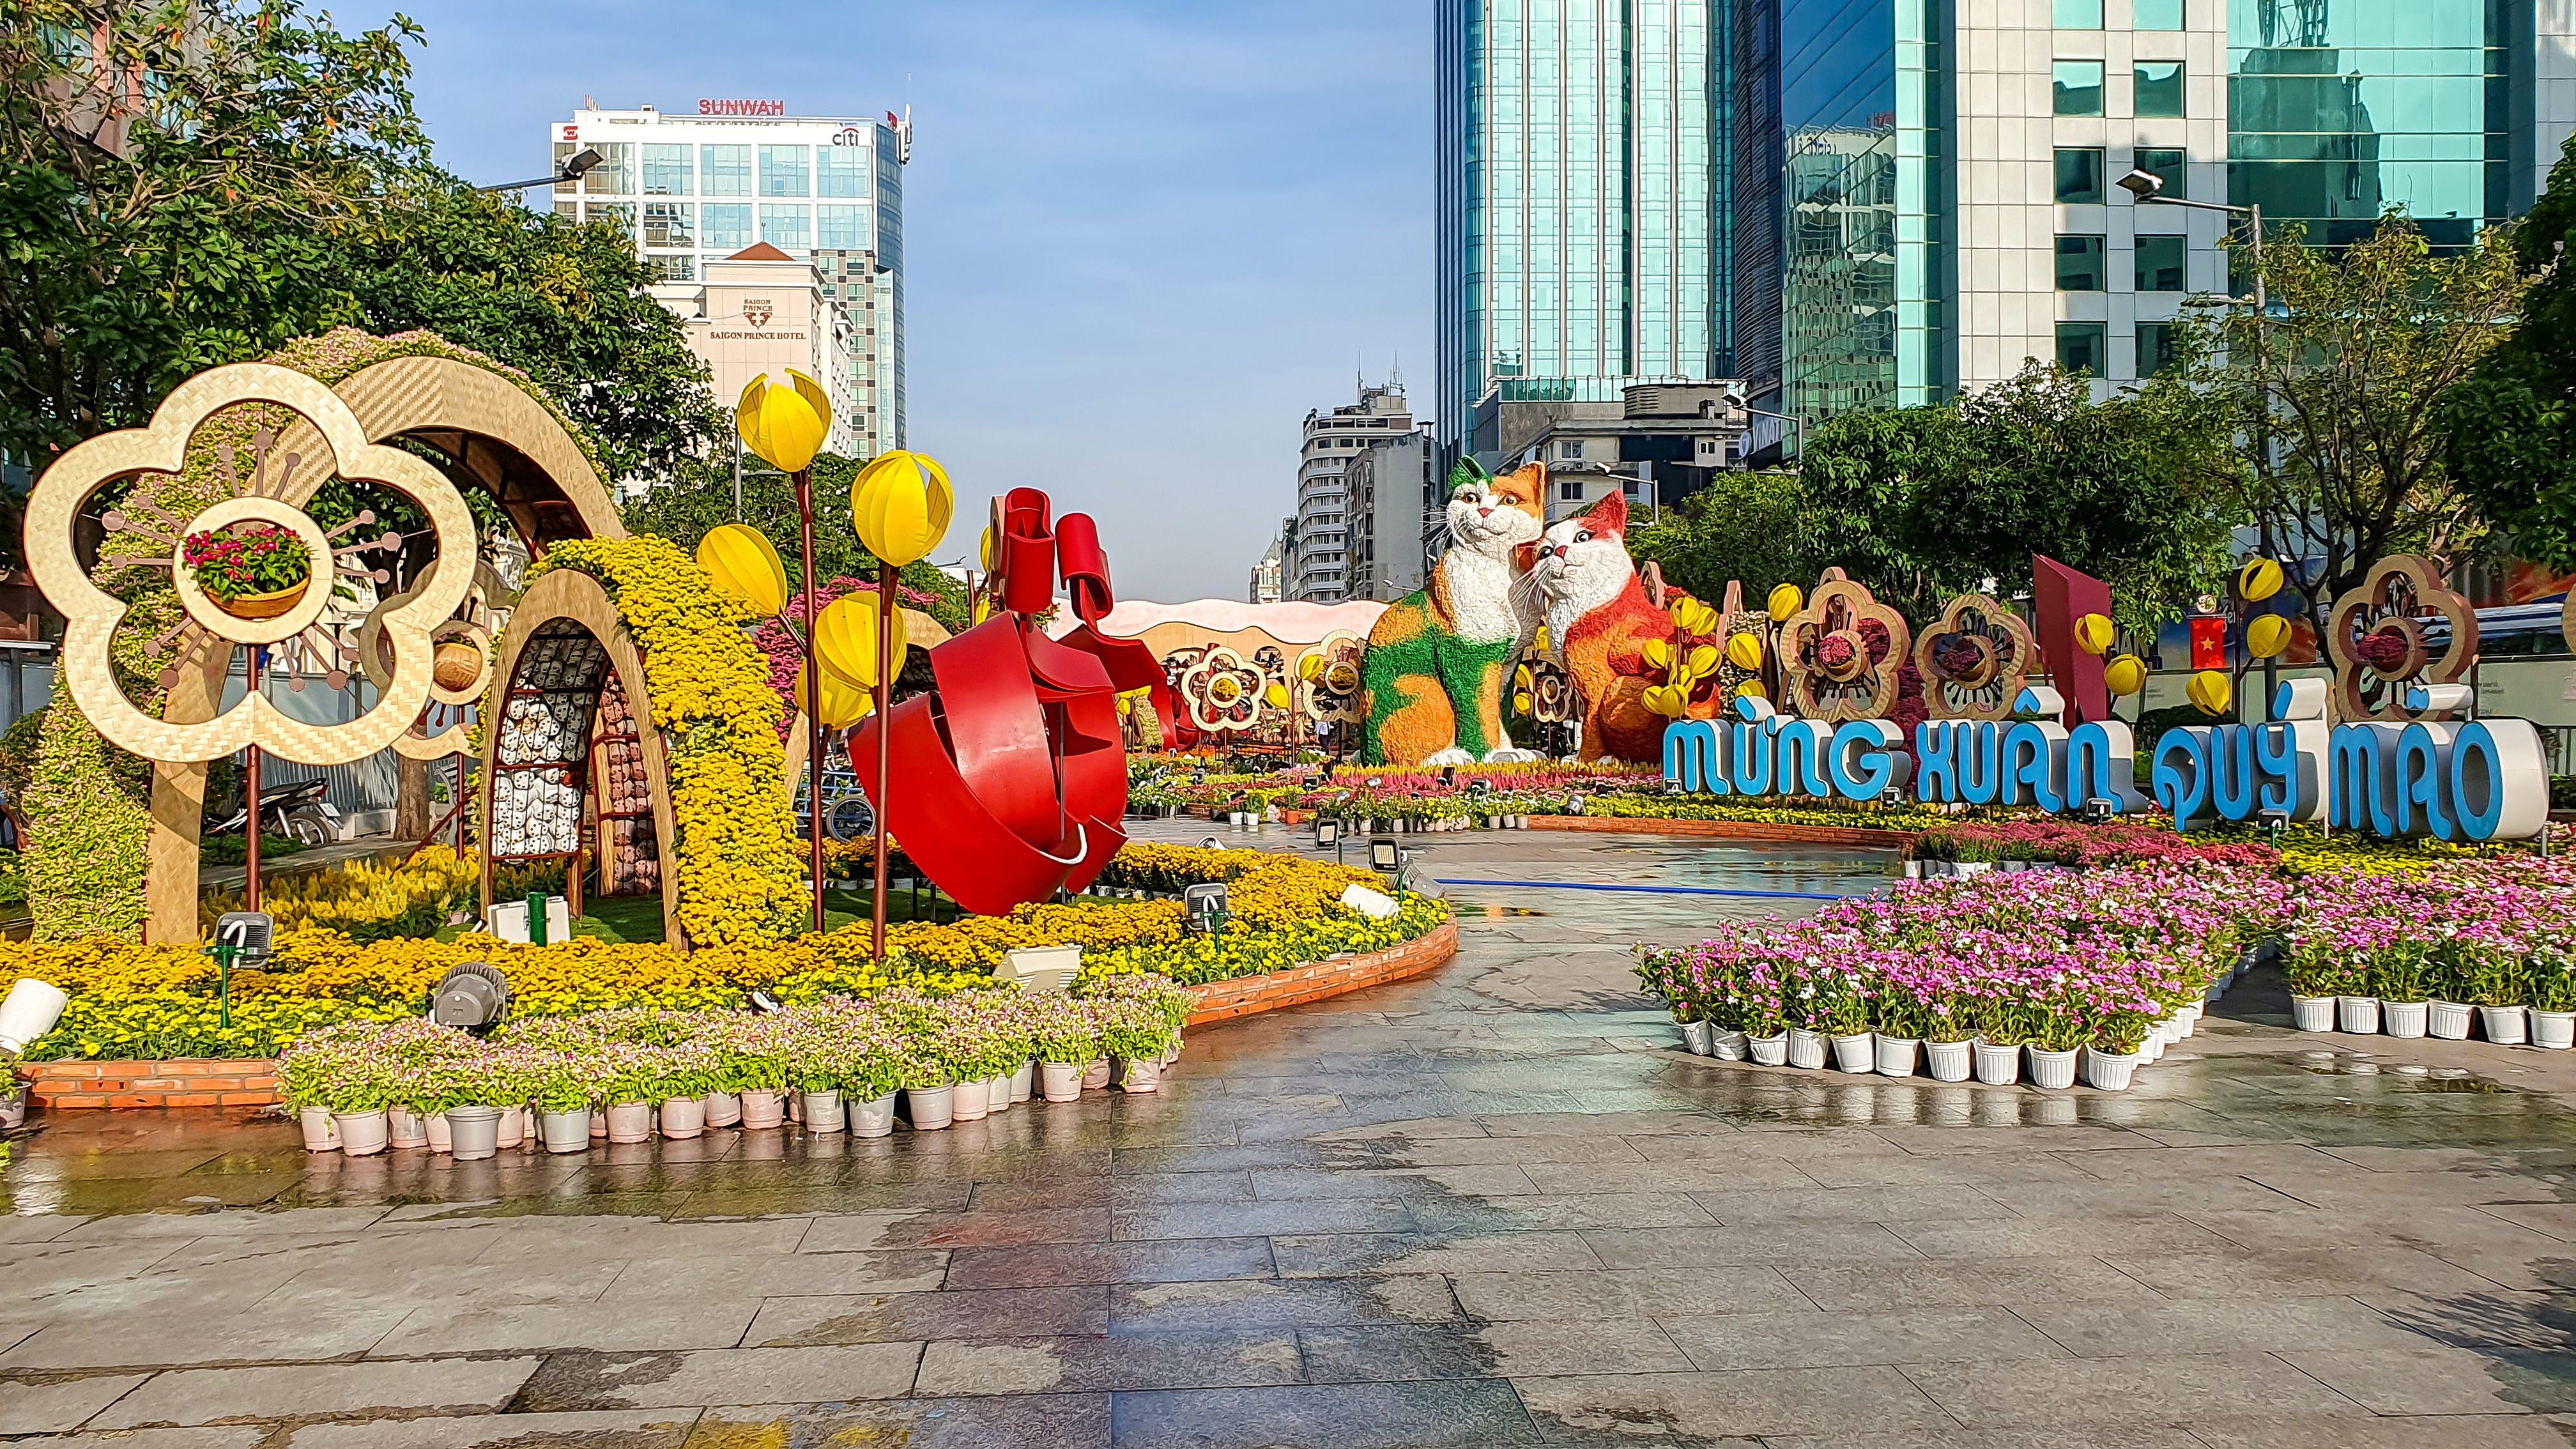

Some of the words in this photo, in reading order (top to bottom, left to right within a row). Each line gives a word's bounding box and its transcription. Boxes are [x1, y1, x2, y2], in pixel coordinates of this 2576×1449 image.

[699, 99, 784, 116] SUNWAH
[832, 128, 859, 146] citi
[1664, 695, 1894, 802] MỪNG
[1916, 686, 2126, 814] XUÂN
[2152, 681, 2300, 832] QUÝ
[2331, 687, 2506, 841] MÃO
